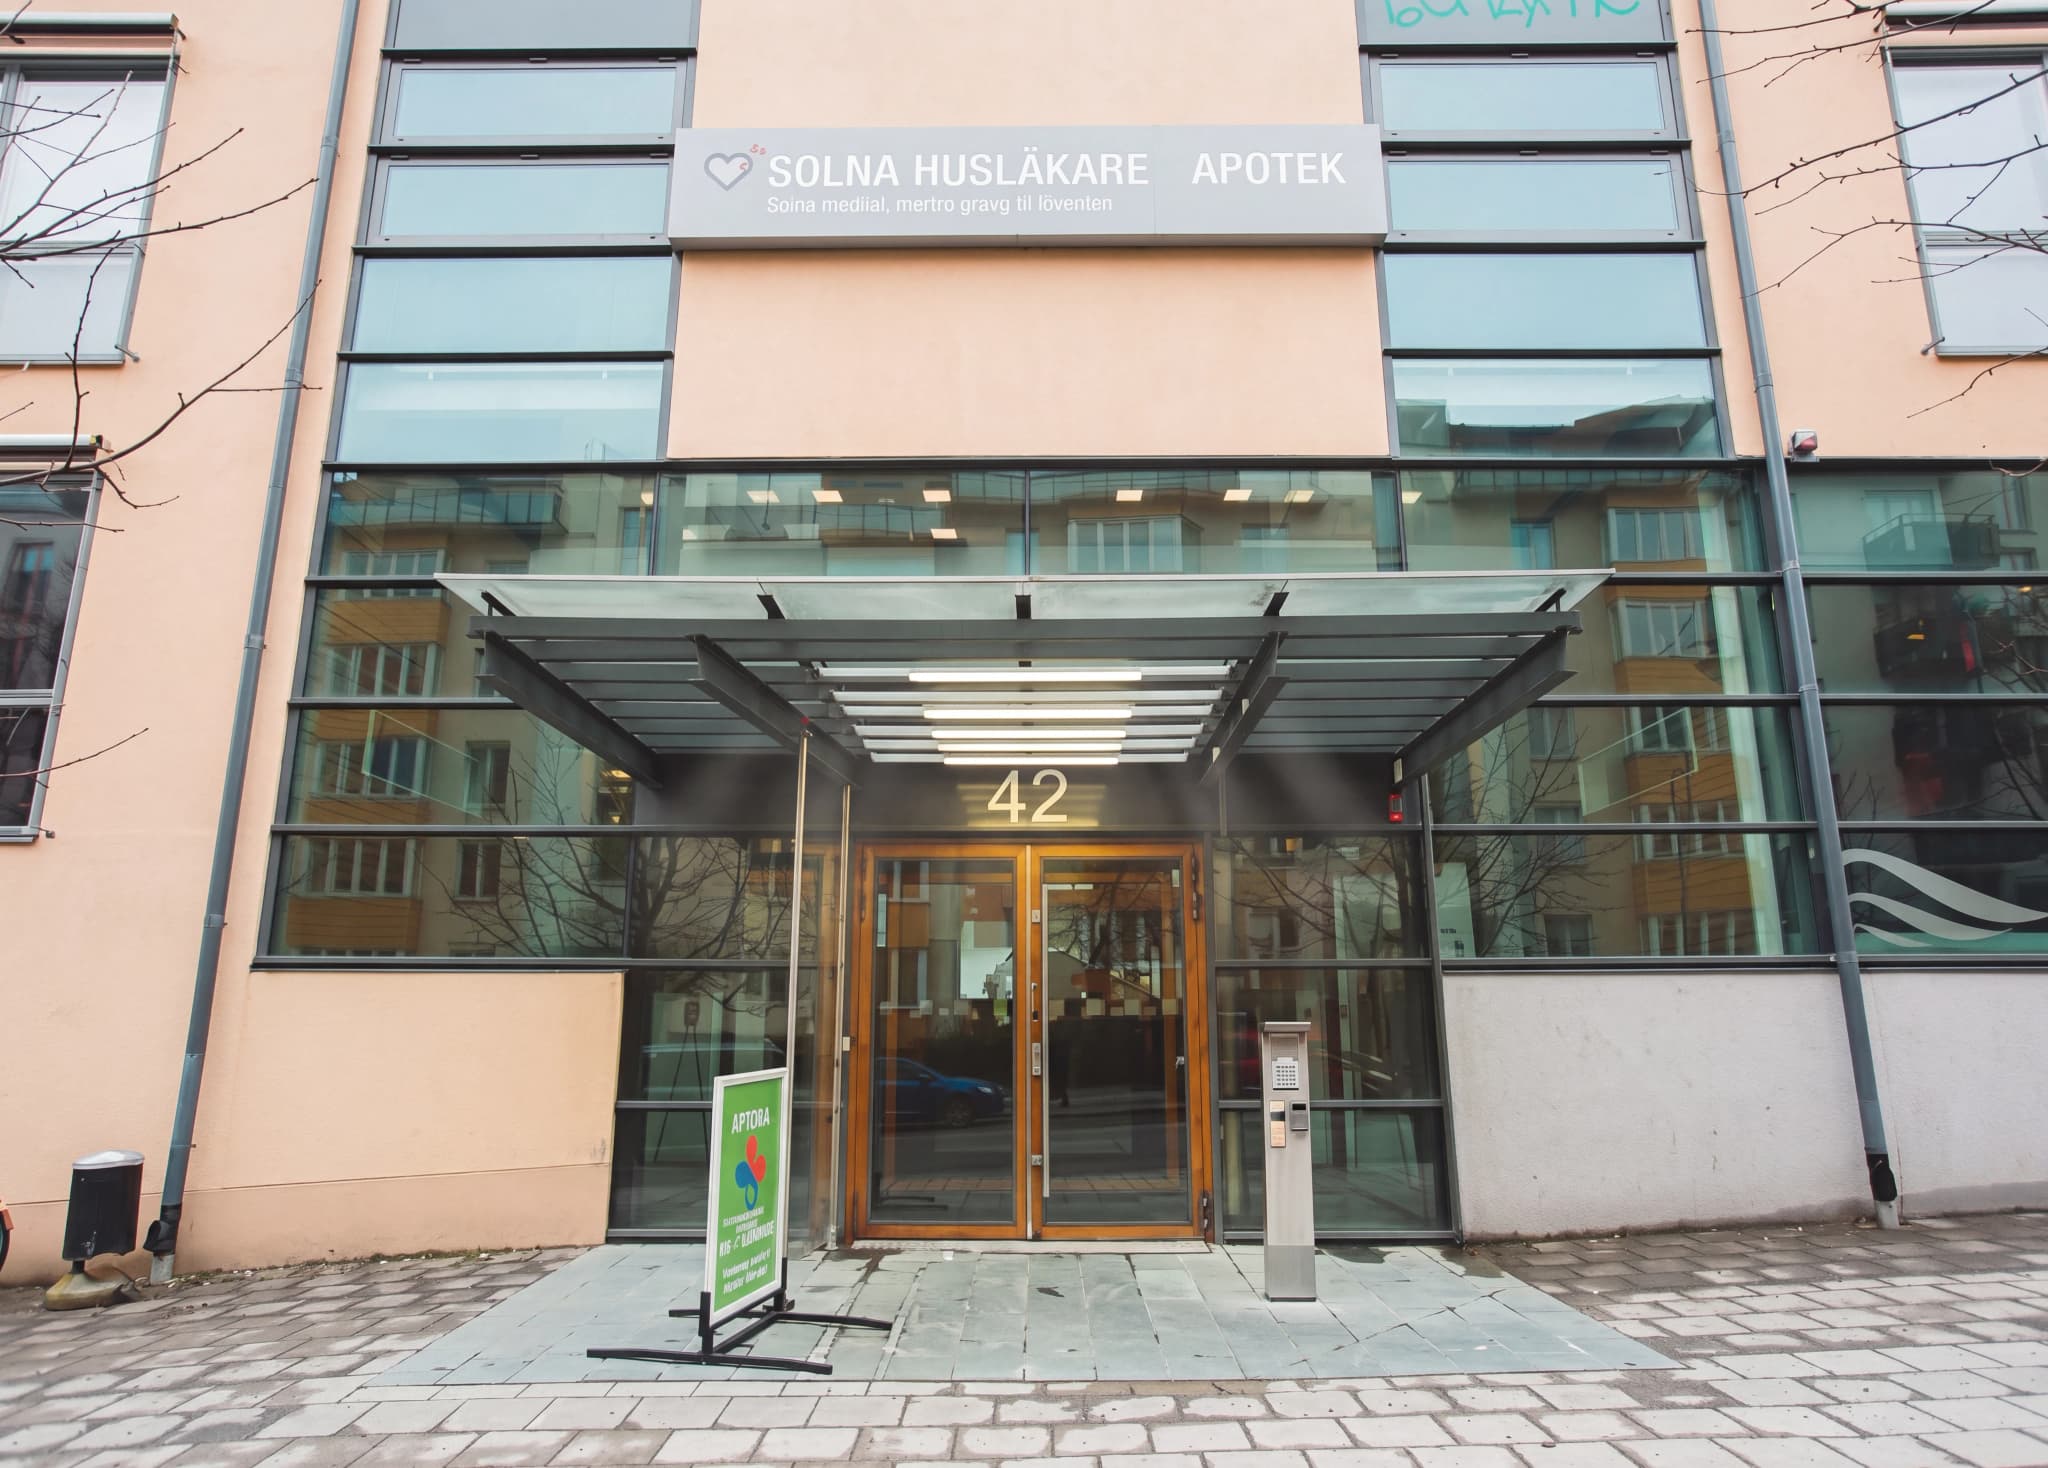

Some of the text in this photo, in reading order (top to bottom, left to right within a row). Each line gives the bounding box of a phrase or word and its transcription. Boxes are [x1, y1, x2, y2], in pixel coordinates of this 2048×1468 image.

[768, 146, 1150, 188] SOLNA HUSLÄKARE
[1191, 151, 1348, 185] APOTEK
[896, 195, 955, 213] mertro
[960, 198, 1010, 216] gravg
[1016, 194, 1032, 212] til
[1038, 194, 1113, 212] löventen
[987, 768, 1068, 824] 42
[731, 1106, 770, 1135] APTORA
